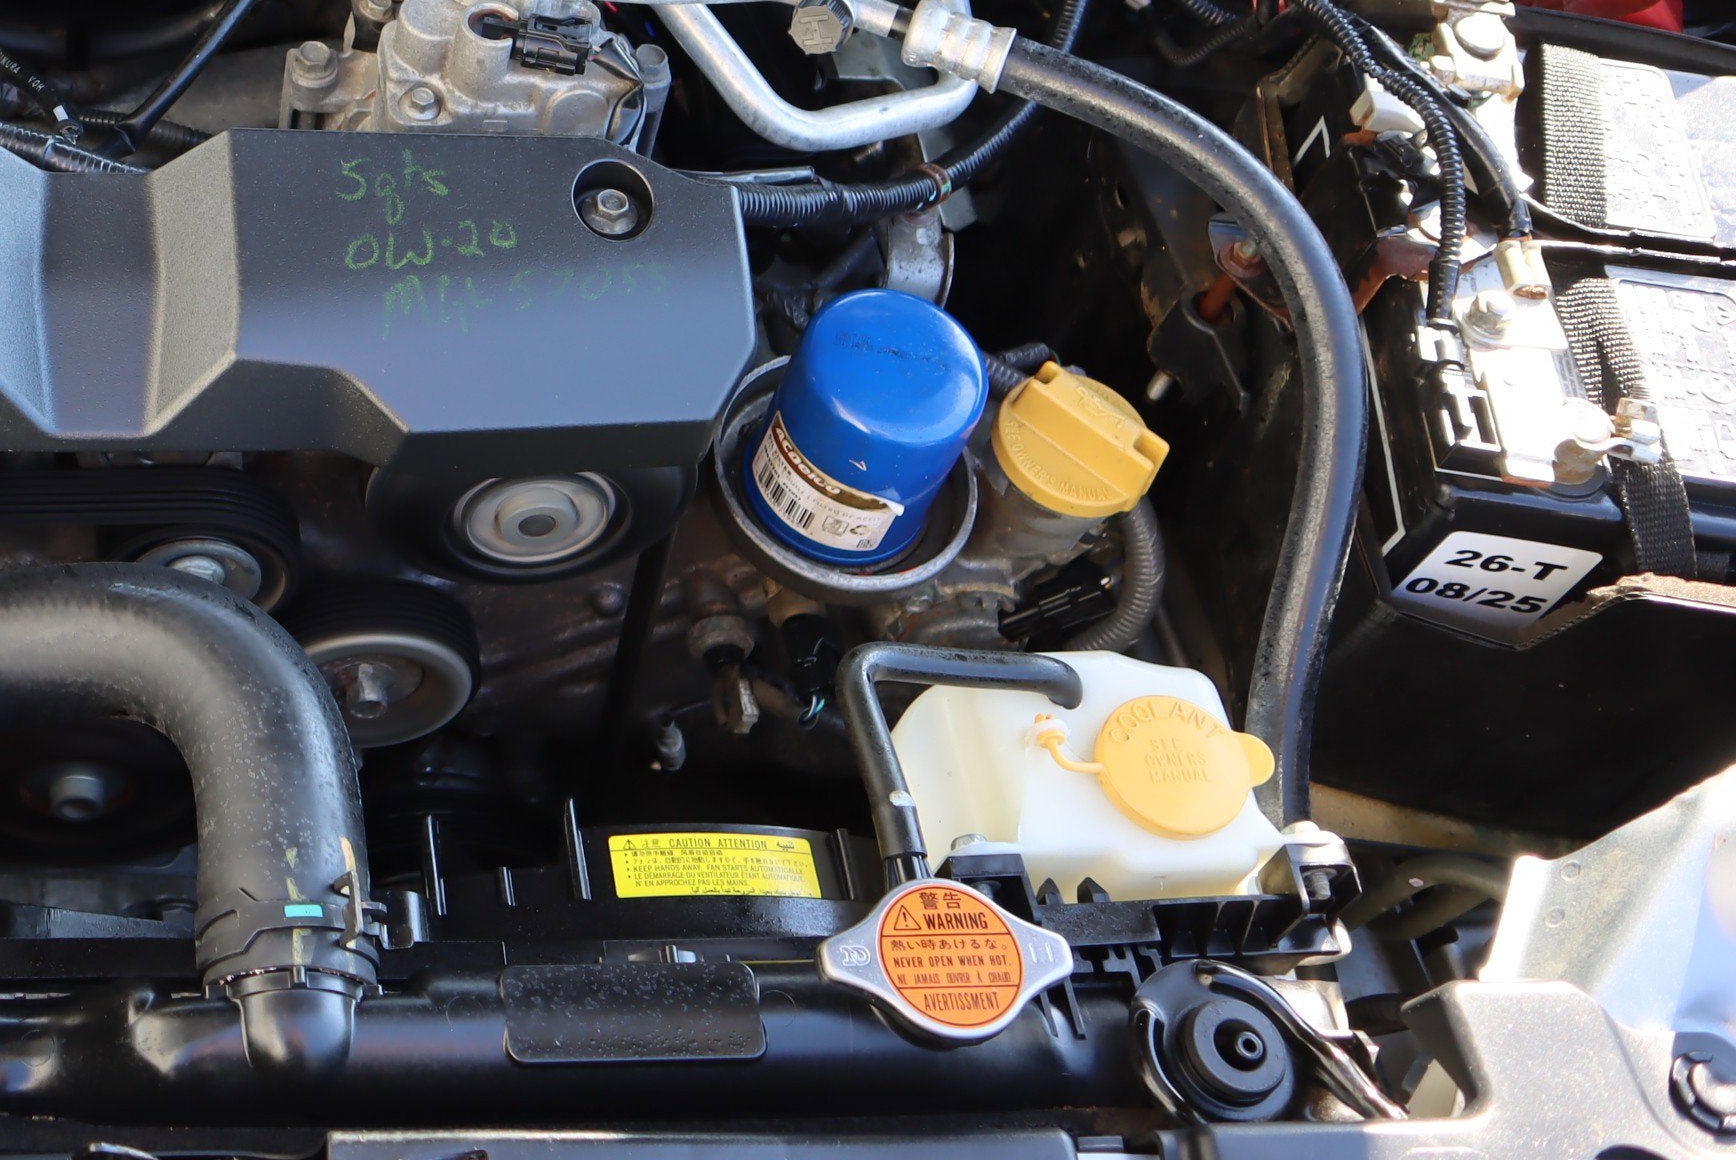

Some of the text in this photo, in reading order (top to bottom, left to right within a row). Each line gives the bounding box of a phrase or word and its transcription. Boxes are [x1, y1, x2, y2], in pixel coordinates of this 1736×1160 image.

[1444, 549, 1568, 581] 26-T
[1405, 577, 1549, 614] 08/25
[1108, 700, 1226, 743] COOLANT
[1149, 768, 1213, 784] MANUAL
[669, 838, 768, 850] CAUTION ATTENTION
[634, 872, 642, 880] LE
[919, 891, 962, 910] 警告
[923, 911, 989, 930] WARNING
[893, 956, 924, 968] NEVER
[928, 955, 954, 967] OPEN
[957, 955, 984, 966] WHEN
[924, 991, 1000, 1011] AVERTISSMENT
